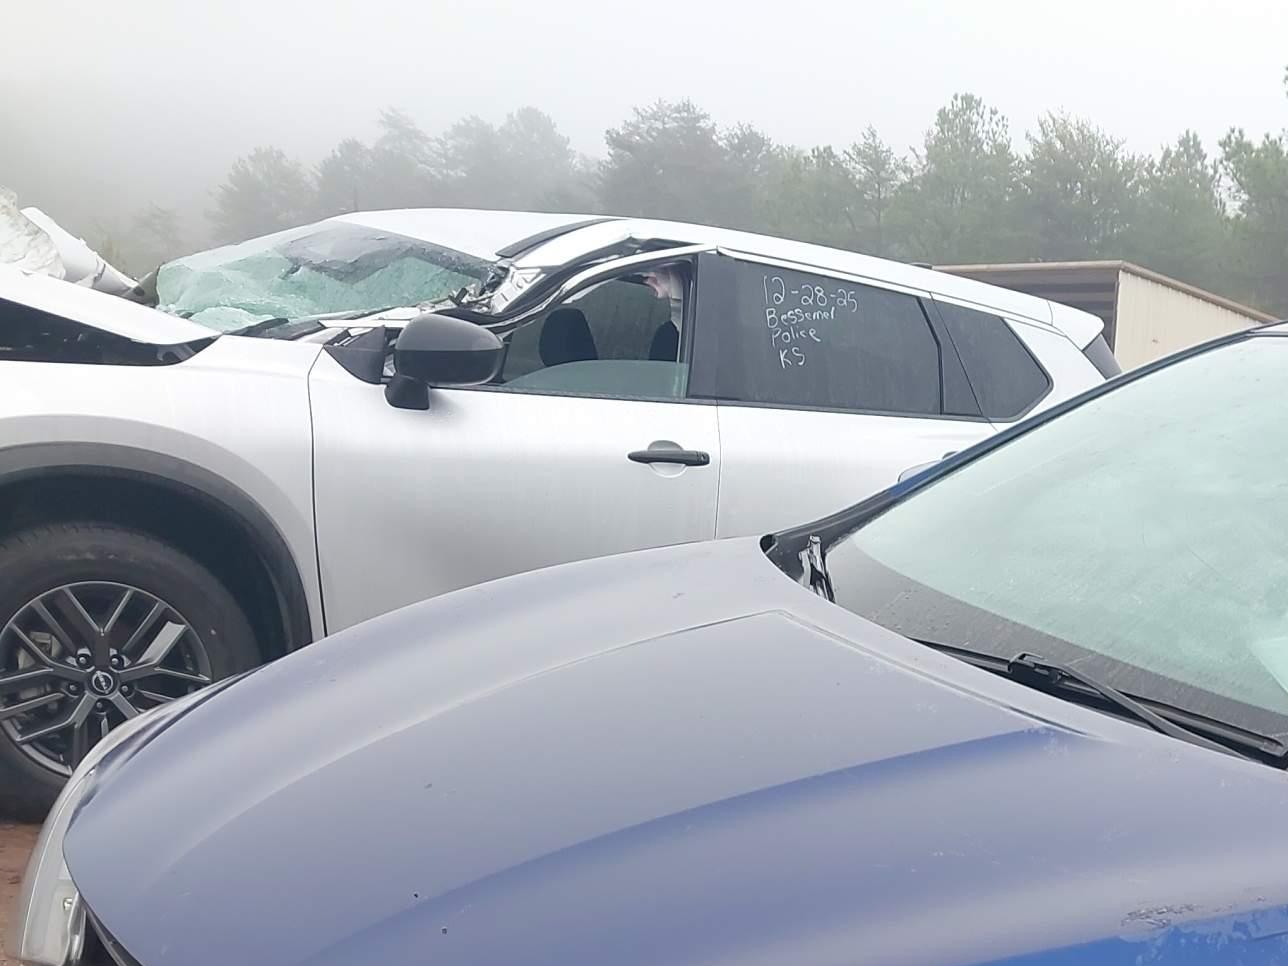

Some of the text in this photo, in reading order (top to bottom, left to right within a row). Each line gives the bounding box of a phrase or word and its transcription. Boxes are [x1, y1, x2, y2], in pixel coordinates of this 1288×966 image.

[762, 275, 858, 313] 12-28-25
[766, 307, 836, 329] Bessemer
[771, 327, 822, 347] Police
[779, 346, 806, 369] KS
